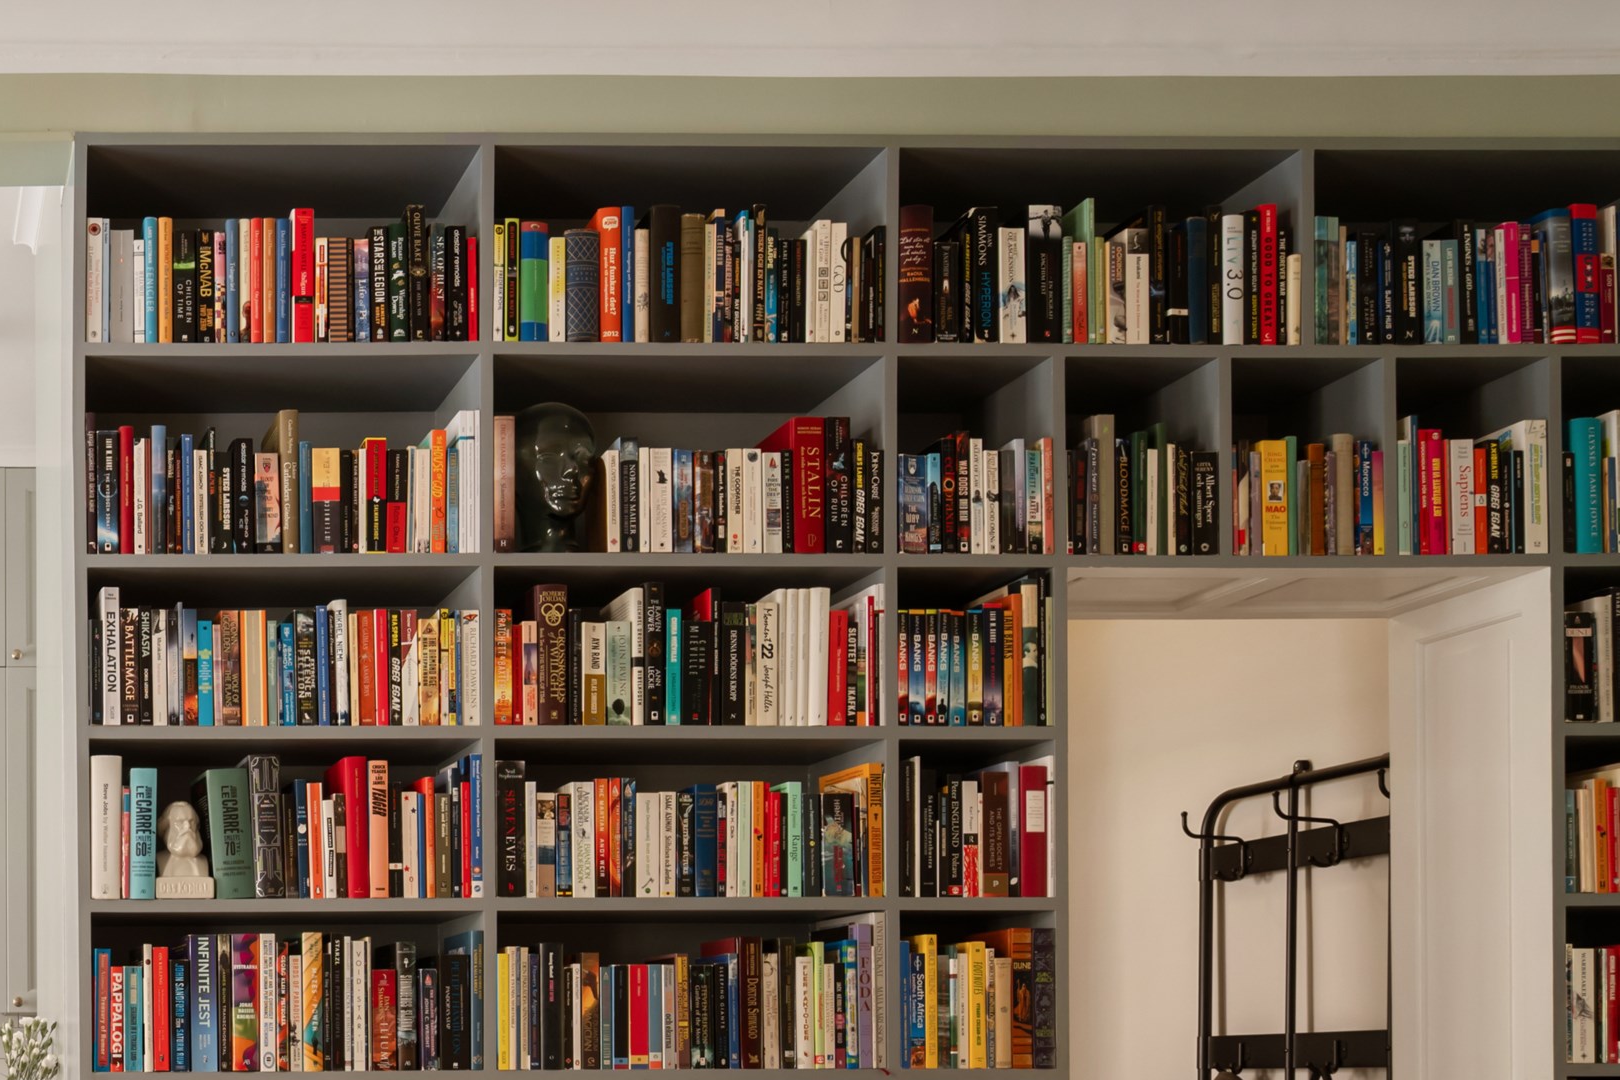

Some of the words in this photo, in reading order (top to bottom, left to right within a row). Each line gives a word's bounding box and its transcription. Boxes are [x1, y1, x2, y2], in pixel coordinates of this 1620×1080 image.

[413, 212, 421, 237] OLIVIE
[373, 236, 384, 264] STARS
[436, 236, 444, 254] SEA
[977, 215, 987, 266] SIMMONS
[1264, 237, 1273, 267] GOOD
[199, 250, 212, 297] McNAB
[436, 255, 444, 269] OF
[609, 263, 617, 291] funkar
[757, 270, 764, 279] EN
[177, 283, 184, 295] OF
[359, 279, 367, 298] Life
[374, 271, 385, 303] LEGION
[436, 270, 444, 300] RUST
[833, 265, 845, 293] GOD
[1264, 273, 1273, 287] TO
[397, 289, 405, 319] Watership
[609, 293, 617, 315] det?
[981, 272, 991, 327] HYPERION
[1264, 292, 1273, 328] GREAT
[1432, 279, 1440, 312] BROWN
[359, 310, 368, 320] Pi
[1588, 427, 1596, 467] ULYSSES
[807, 447, 819, 518] STALIN
[830, 480, 838, 493] OF
[1196, 473, 1204, 486] och
[1205, 473, 1214, 498] Albert
[1362, 461, 1370, 496] Morocco
[1456, 465, 1471, 517] Sapiens
[840, 475, 848, 527] CHILDREN
[855, 489, 864, 514] GREG
[1120, 456, 1130, 532] BLOODMAGE
[1195, 487, 1204, 527] sanningen
[629, 504, 637, 535] MAILER
[1205, 500, 1214, 524] Speer
[1590, 507, 1598, 537] JOYCE
[856, 516, 864, 542] EGAN
[647, 605, 655, 632] TOWER
[761, 607, 772, 642] Moment
[141, 611, 150, 657] SHIKASTA
[591, 637, 600, 652] AYN
[618, 634, 626, 659] JOHN
[848, 627, 856, 663] SLOTTET
[106, 611, 117, 692] EXHALATION
[124, 625, 135, 701] BATTLEMAGE
[557, 627, 566, 703] CROSSROADS
[591, 654, 600, 669] RAND
[762, 643, 773, 659] 22
[913, 634, 922, 672] BANKS
[928, 634, 936, 672] BANKS
[971, 633, 980, 670] BANKS
[391, 657, 400, 682] GREG
[654, 669, 662, 686] ANN
[762, 665, 772, 689] Joseph
[392, 683, 400, 710] EGAN
[763, 690, 772, 713] Heller
[848, 690, 857, 716] KAFKA
[372, 787, 387, 817] YEAGER
[870, 773, 882, 807] INFINITE
[951, 781, 959, 799] Peter
[505, 790, 516, 871] SEVENEVES
[951, 801, 960, 847] ENGLUND
[951, 853, 959, 878] Poltava
[198, 937, 210, 993] INFINITE
[112, 972, 122, 1058] PAPPALOGI
[198, 997, 210, 1028] JEST
[917, 1002, 925, 1028] Africa
